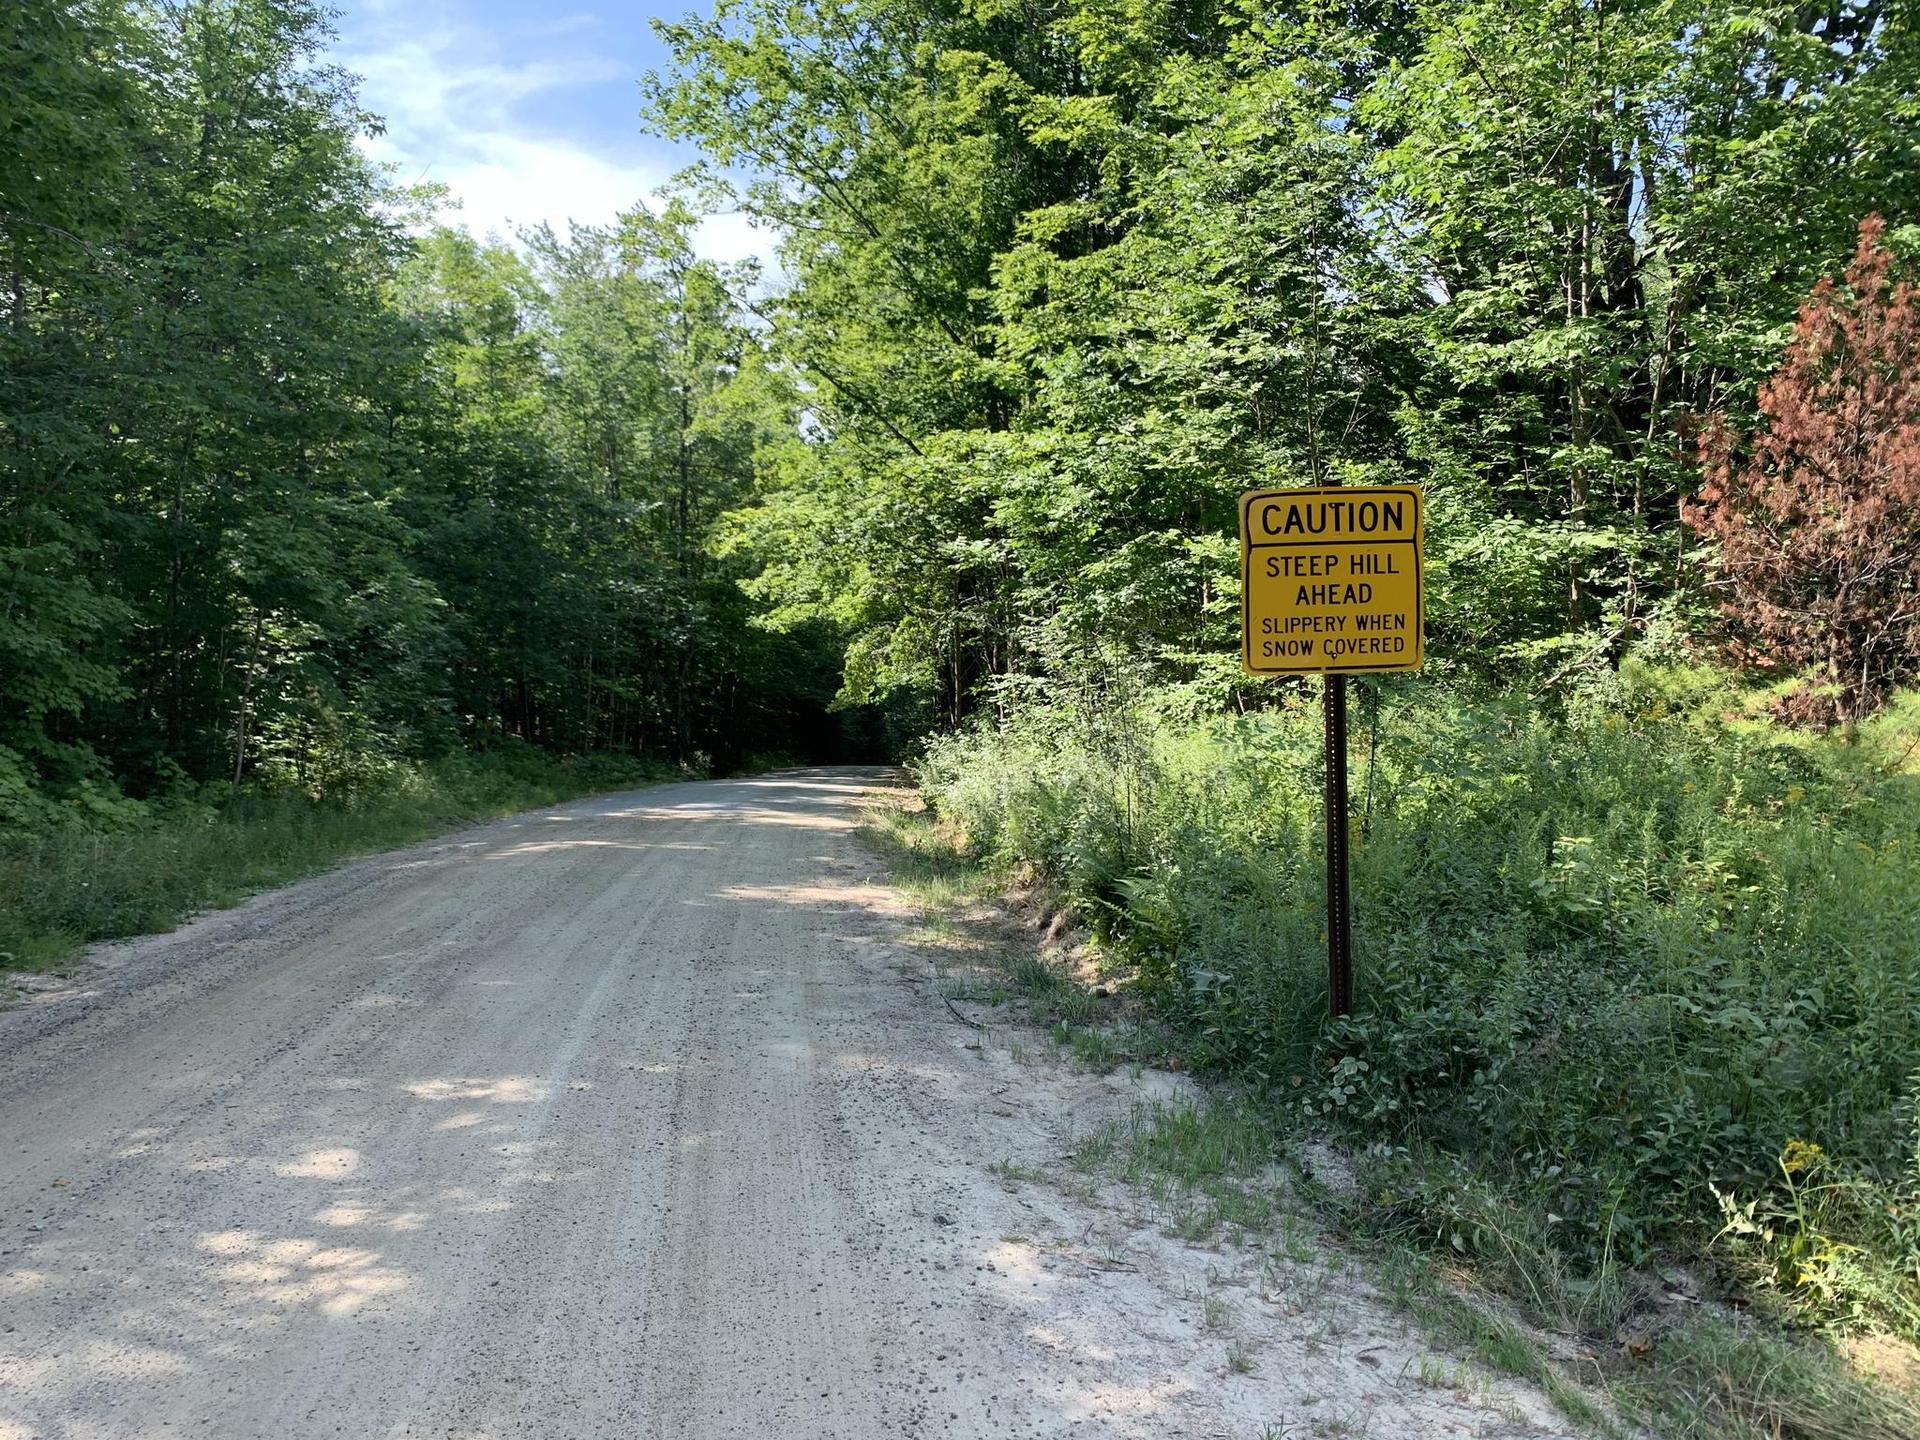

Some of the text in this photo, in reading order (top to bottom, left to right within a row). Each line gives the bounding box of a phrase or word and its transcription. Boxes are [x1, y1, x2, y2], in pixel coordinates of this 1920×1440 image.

[1261, 501, 1403, 536] CAUTION
[1266, 553, 1400, 578] STEEP HILL
[1295, 583, 1373, 606] AHEAD
[1261, 613, 1405, 635] SLIPPERY WHEN
[1262, 636, 1405, 658] SNOW COVERED
